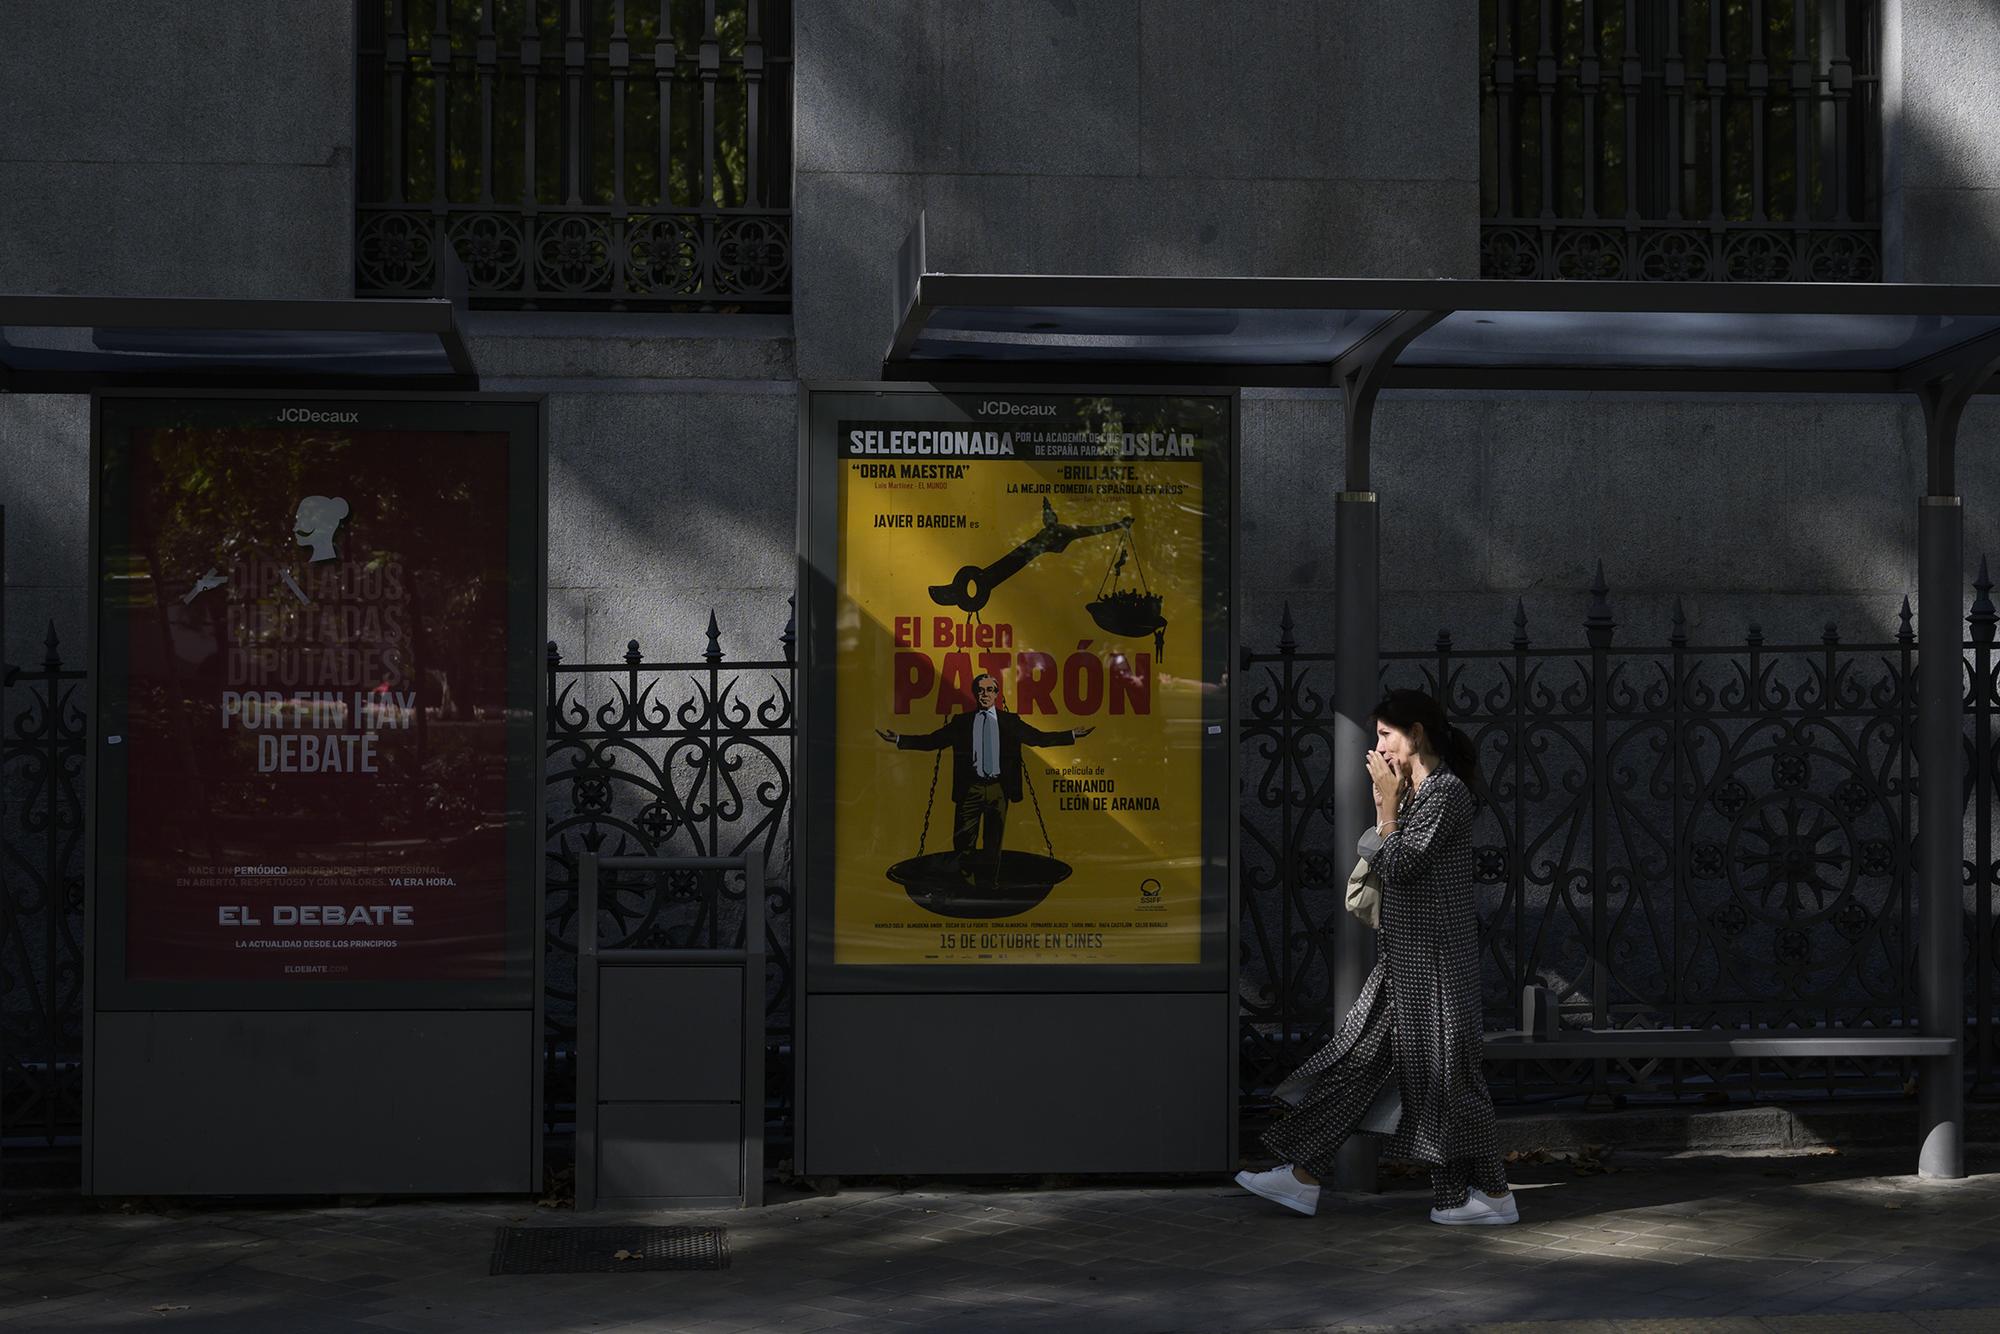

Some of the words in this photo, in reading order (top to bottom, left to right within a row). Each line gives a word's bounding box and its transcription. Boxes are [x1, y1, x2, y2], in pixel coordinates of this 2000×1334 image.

[277, 408, 360, 424] JCDecaux
[978, 400, 1057, 417] JCDecaux
[849, 430, 1016, 456] SELECCIONADA
[1015, 432, 1032, 442] POR
[1033, 432, 1044, 442] LA
[1045, 432, 1088, 443] ACADEMIA
[1089, 432, 1100, 444] DE
[1035, 445, 1045, 456] DE
[1046, 443, 1079, 457] ESPAÑA
[1080, 445, 1101, 457] PARA
[1006, 483, 1019, 494] LA
[1021, 483, 1051, 495] MEJOR
[1053, 483, 1094, 495] COMEDIA
[873, 514, 913, 529] JAVIER
[917, 514, 967, 529] BARDEM
[969, 521, 980, 529] es
[894, 616, 921, 648] El
[933, 616, 1013, 648] Buen
[894, 639, 1151, 716] PATRÓN
[222, 690, 284, 730] POR
[294, 690, 346, 730] FIN
[354, 690, 416, 730] HAY
[257, 734, 379, 773] DEBATE
[1045, 768, 1060, 776] una
[1062, 765, 1093, 777] película
[1095, 766, 1105, 776] de
[1052, 779, 1115, 793] FERNANDO
[1059, 793, 1090, 811] LEÓN
[1093, 797, 1108, 811] DE
[1111, 797, 1161, 811] ARANOA
[187, 866, 214, 876] NACE
[233, 863, 288, 877] PERIÓDICO
[176, 877, 191, 887] EN
[192, 877, 239, 888] ABIERTO,
[240, 877, 306, 887] RESPETUOSO
[306, 877, 316, 887] Y
[316, 877, 338, 887] CON
[388, 877, 402, 887] YA
[403, 877, 424, 887] ERA
[425, 877, 457, 887] HORA.
[218, 905, 262, 926] EL
[272, 905, 415, 926] DEBATE
[235, 939, 247, 949] LA
[248, 939, 302, 949] ACTUALIDAD
[303, 939, 331, 949] DESDE
[332, 939, 348, 949] LOS
[350, 939, 398, 949] PRINCIPIOS
[940, 933, 956, 949] 15
[960, 933, 977, 949] DE
[981, 933, 1040, 949] OCTUBRE
[1044, 933, 1061, 949] EN
[1065, 933, 1104, 949] CINES
